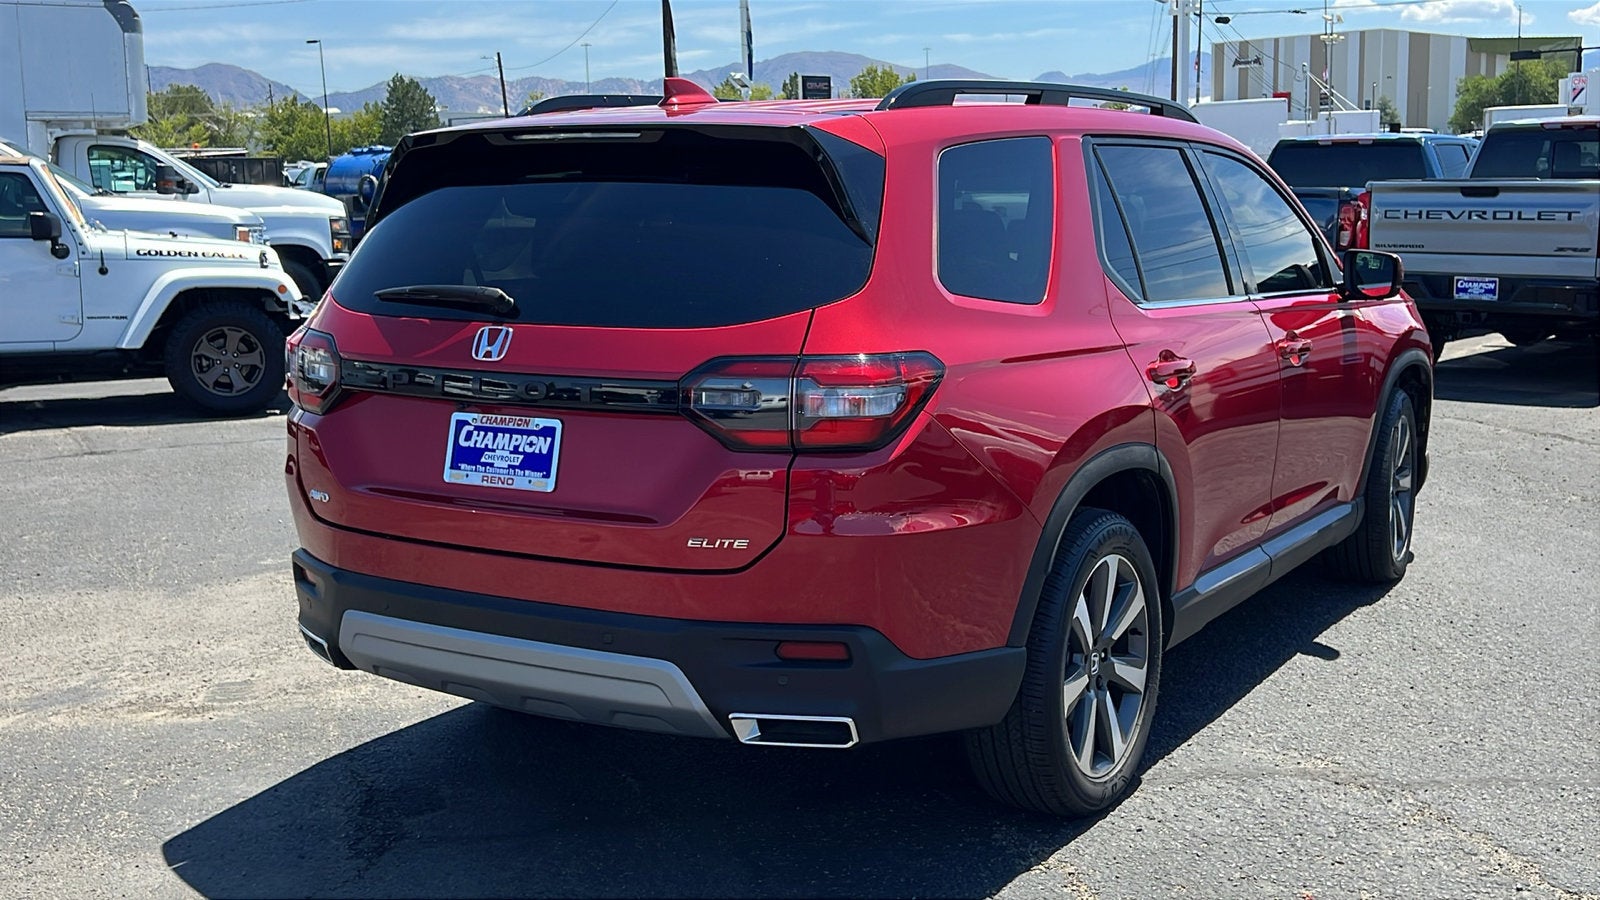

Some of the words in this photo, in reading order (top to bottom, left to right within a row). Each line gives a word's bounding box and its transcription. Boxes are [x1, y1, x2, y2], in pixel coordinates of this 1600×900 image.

[806, 81, 829, 90] GMC
[1383, 209, 1581, 221] CHEVROLET
[136, 249, 199, 257] GOLDEN
[1457, 280, 1496, 290] CHAMPION
[480, 415, 532, 428] CHAMPION
[458, 425, 552, 455] CHAMPION
[483, 453, 521, 464] CHEVROLET
[481, 475, 515, 486] RENO
[687, 538, 750, 549] ELITE
